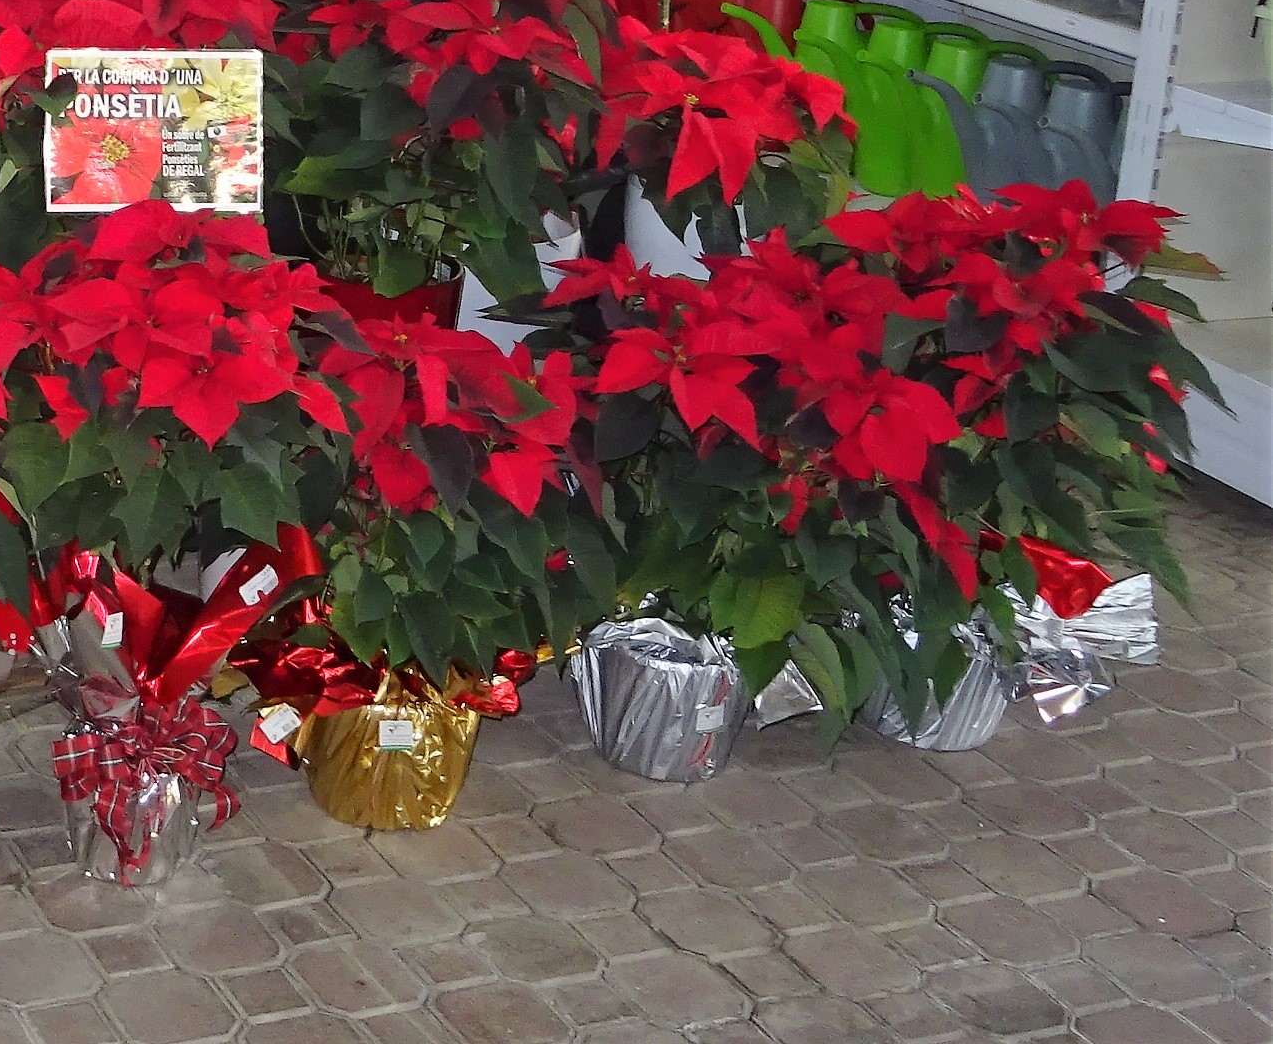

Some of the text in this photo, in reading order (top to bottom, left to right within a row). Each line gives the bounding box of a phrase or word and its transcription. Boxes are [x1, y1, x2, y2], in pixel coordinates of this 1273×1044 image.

[85, 69, 100, 85] LA
[102, 69, 158, 85] COMPRA
[60, 87, 182, 118] ONSÈTIA
[161, 129, 173, 140] Un
[195, 130, 205, 140] de
[162, 165, 205, 177] DE REGAL
